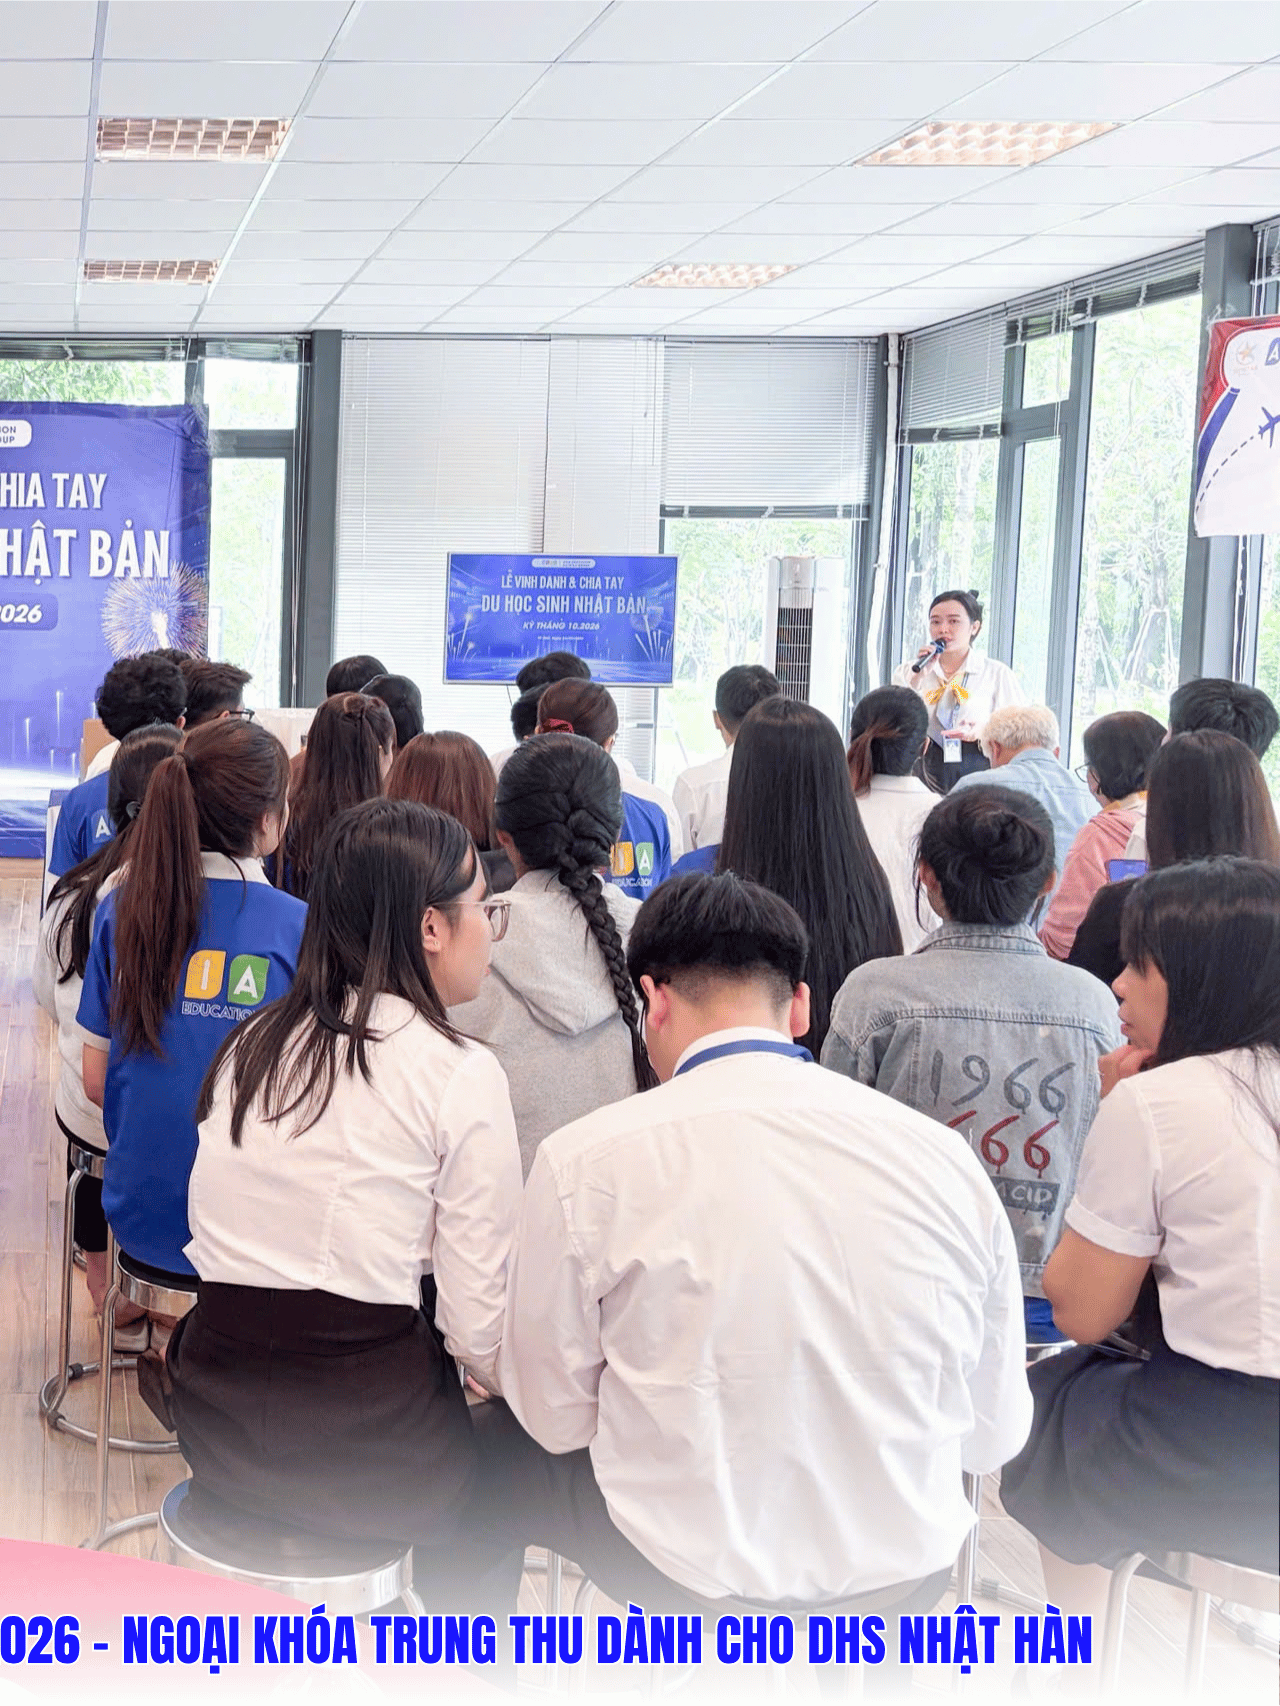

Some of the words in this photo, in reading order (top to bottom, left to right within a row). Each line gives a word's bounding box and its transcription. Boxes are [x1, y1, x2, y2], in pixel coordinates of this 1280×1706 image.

[52, 472, 108, 509] TAY
[89, 518, 170, 579] BẢN
[515, 575, 537, 589] VINH
[540, 575, 567, 590] DANH
[569, 575, 577, 590] &
[579, 576, 602, 590] CHIA
[605, 576, 624, 590] TAY
[481, 594, 500, 612] DU
[504, 594, 532, 616] HỌC
[536, 595, 570, 613] SINH
[574, 593, 613, 618] NHẬT
[616, 592, 648, 615] BẢN
[568, 622, 600, 631] 10.2026
[181, 1001, 254, 1022] EDUCATIO
[930, 1049, 1077, 1119] 1966
[947, 1109, 1060, 1179] 66
